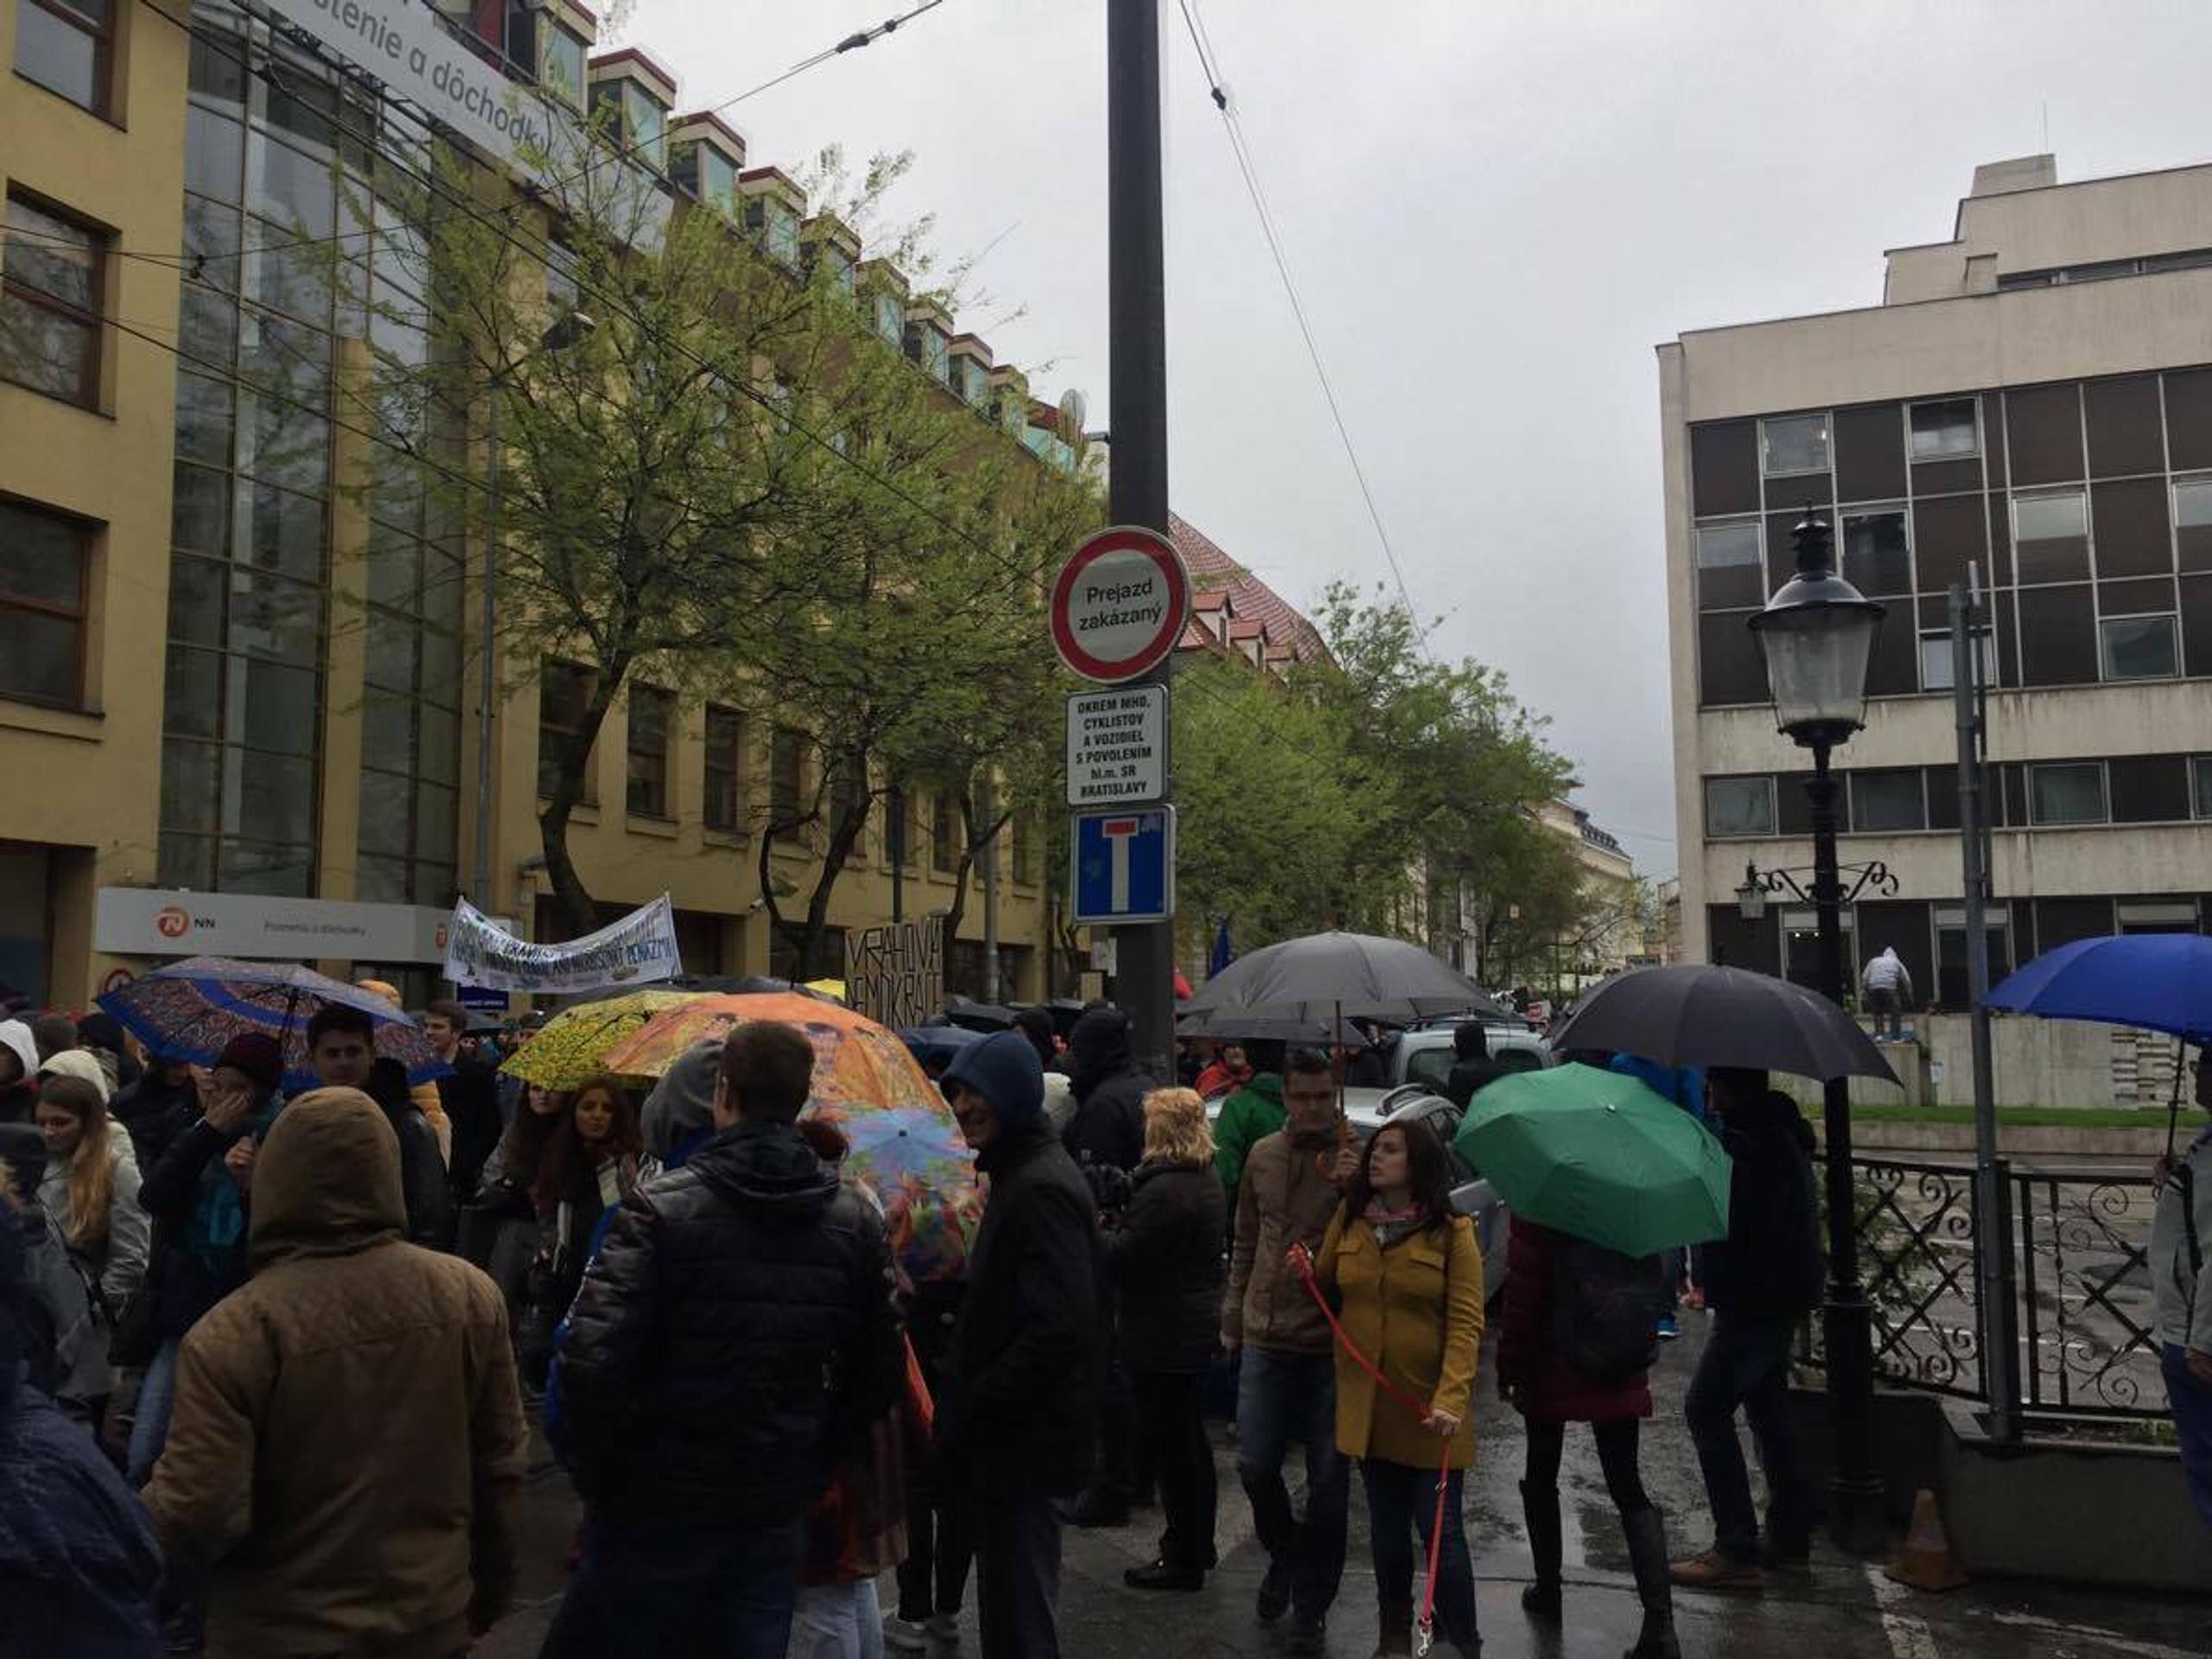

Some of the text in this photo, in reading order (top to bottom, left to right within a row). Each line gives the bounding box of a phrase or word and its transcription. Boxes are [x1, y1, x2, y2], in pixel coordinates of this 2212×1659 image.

[410, 48, 426, 77] a
[1086, 577, 1153, 604] Prejazd
[1079, 601, 1162, 631] zakázaný
[1077, 698, 1117, 715] OKREM
[1084, 713, 1144, 730] CYKLISTOV
[1084, 730, 1144, 747] A VOZIDIEL
[1076, 753, 1084, 765] S
[1121, 765, 1137, 778] SR
[1080, 781, 1147, 798] BRATISLAVY
[194, 918, 215, 929] NN
